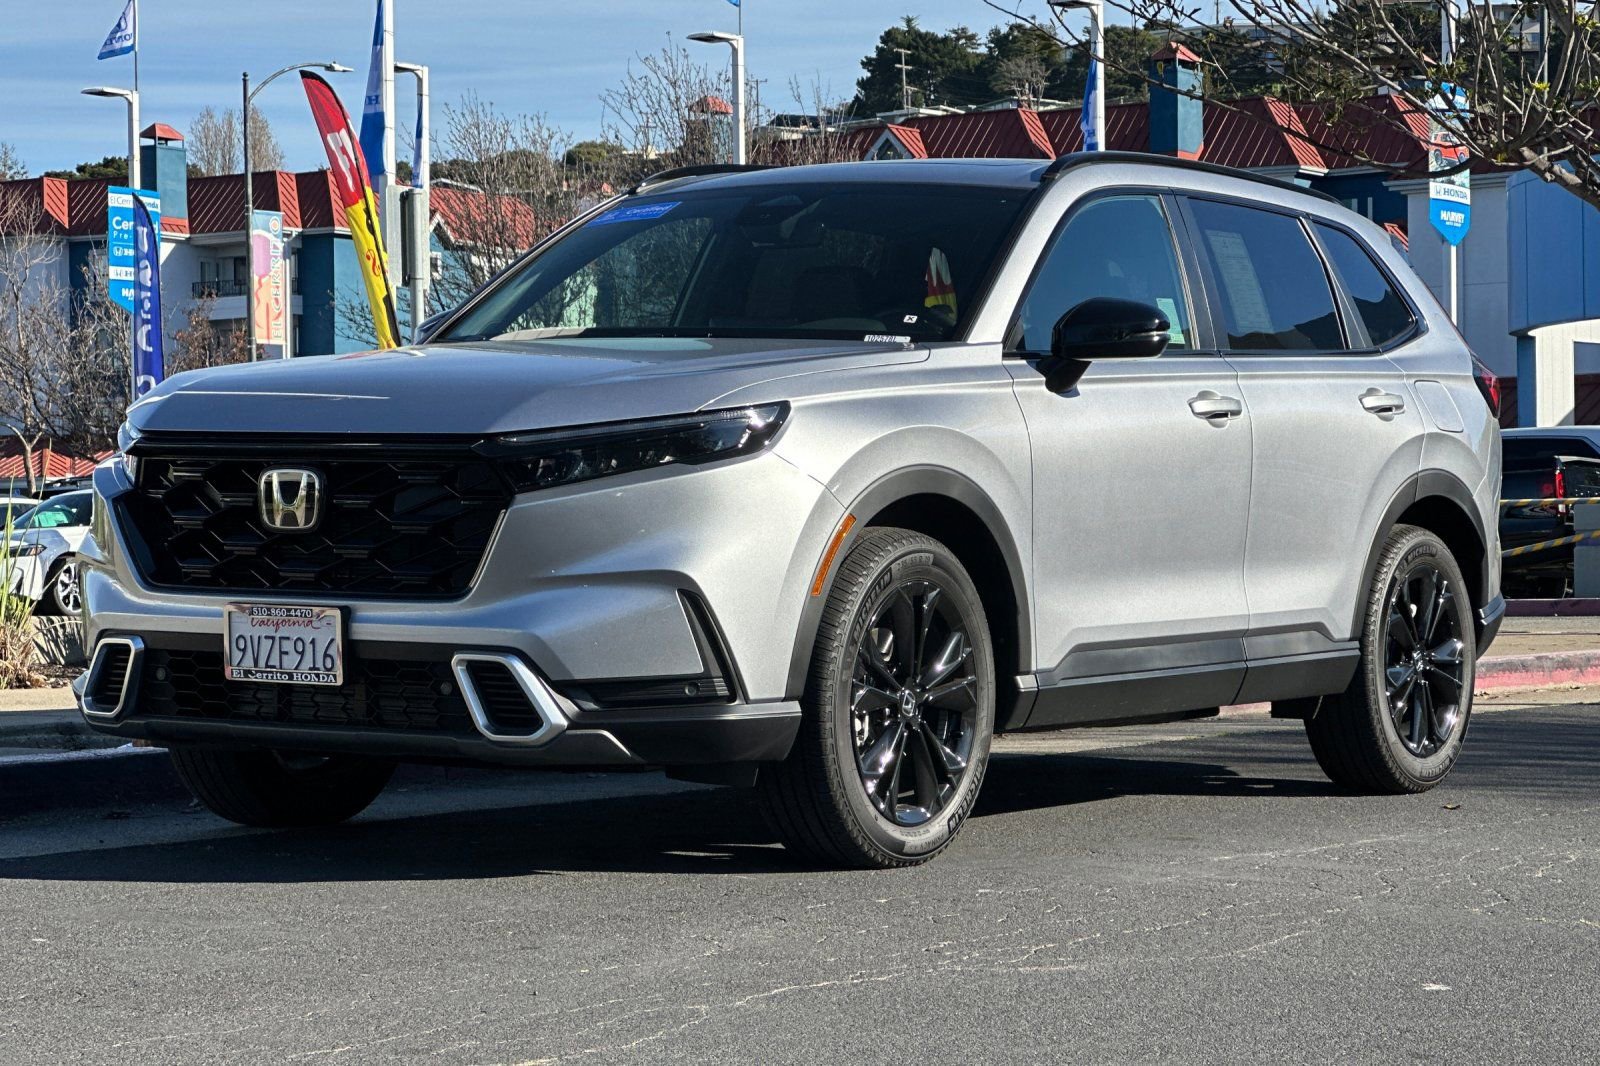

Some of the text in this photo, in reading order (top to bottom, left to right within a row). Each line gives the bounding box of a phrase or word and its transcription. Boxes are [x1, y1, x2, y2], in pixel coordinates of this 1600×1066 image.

[1443, 187, 1467, 200] HONDA
[1441, 210, 1464, 223] HARVEY
[854, 570, 892, 638] MICHELIN
[252, 607, 312, 617] 510-860-4470
[251, 617, 320, 632] California
[235, 635, 335, 671] 9VZF916
[232, 670, 243, 678] El
[293, 673, 335, 683] HONDA
[948, 760, 983, 833] MICHELIN
